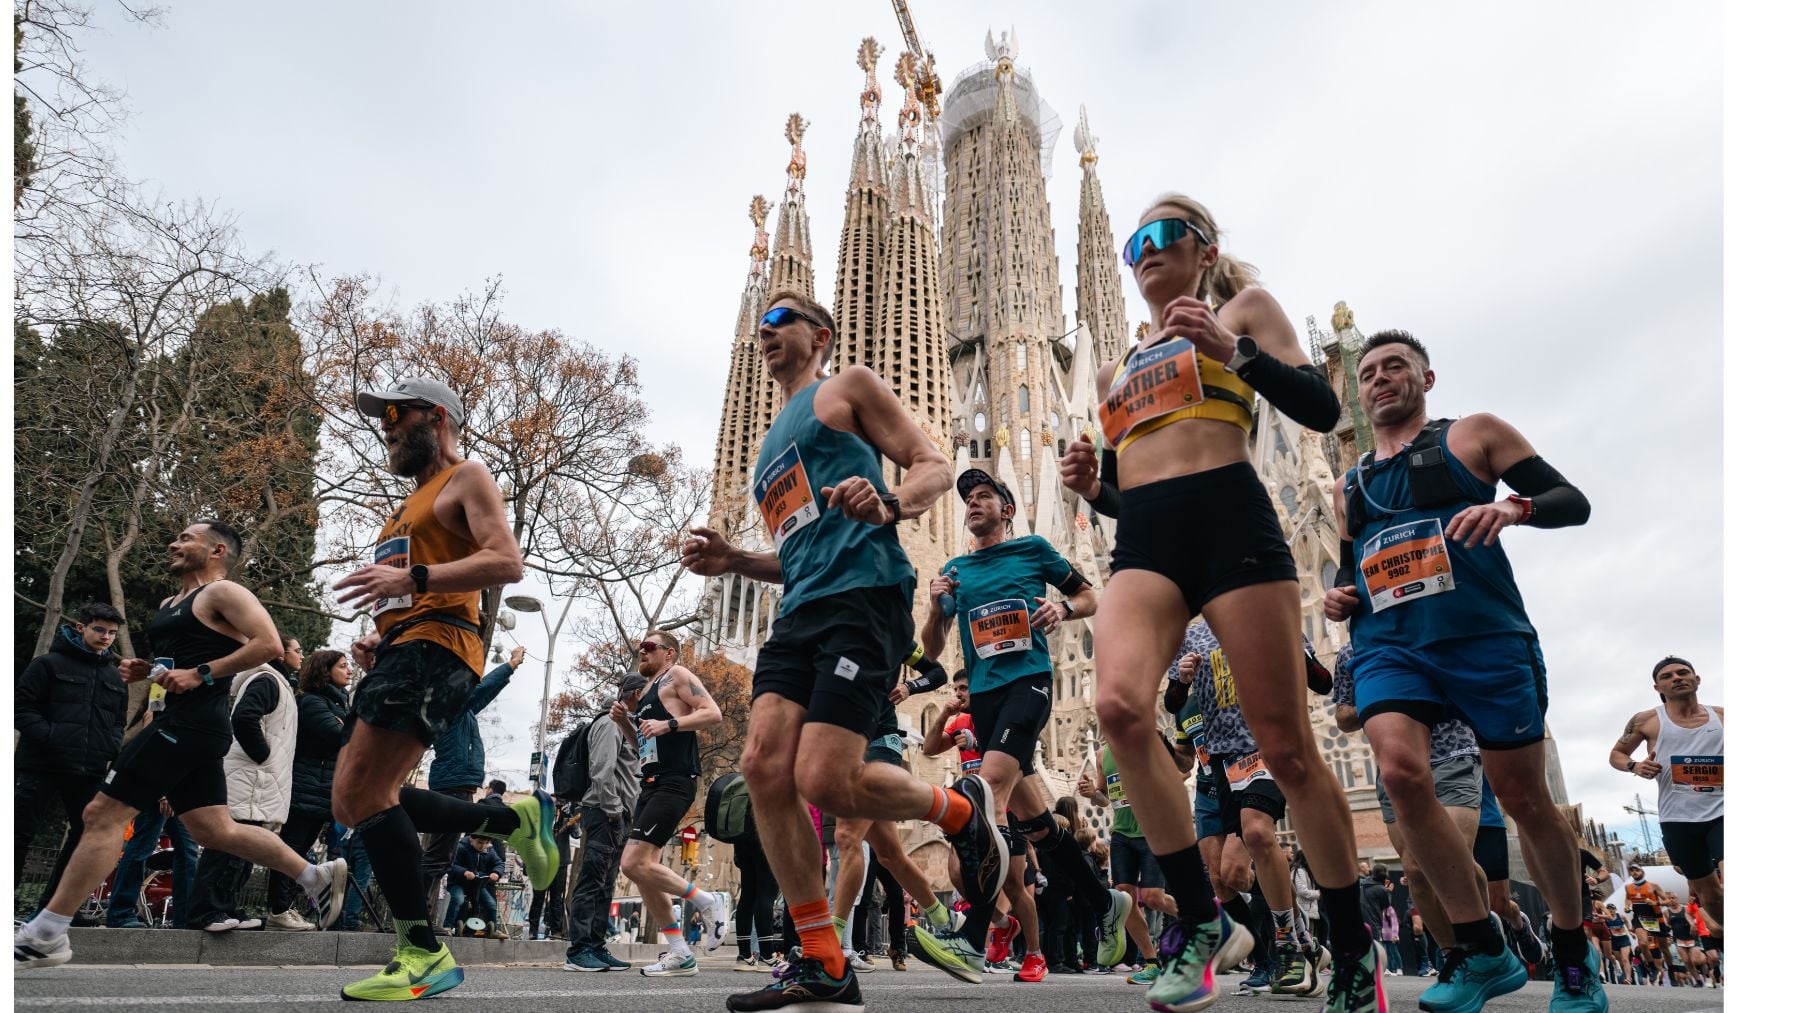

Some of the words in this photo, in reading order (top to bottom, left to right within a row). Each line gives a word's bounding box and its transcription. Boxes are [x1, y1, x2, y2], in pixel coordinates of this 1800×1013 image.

[1107, 360, 1179, 415] HEATHER
[766, 462, 785, 484] ZURICH
[1383, 529, 1416, 545] ZURICH
[1381, 543, 1445, 571] CHRISTOPHE
[1387, 564, 1411, 579] 9902
[990, 604, 1011, 613] ZURICH
[977, 612, 1021, 633] HENDRIK
[1682, 765, 1718, 775] SERGIO
